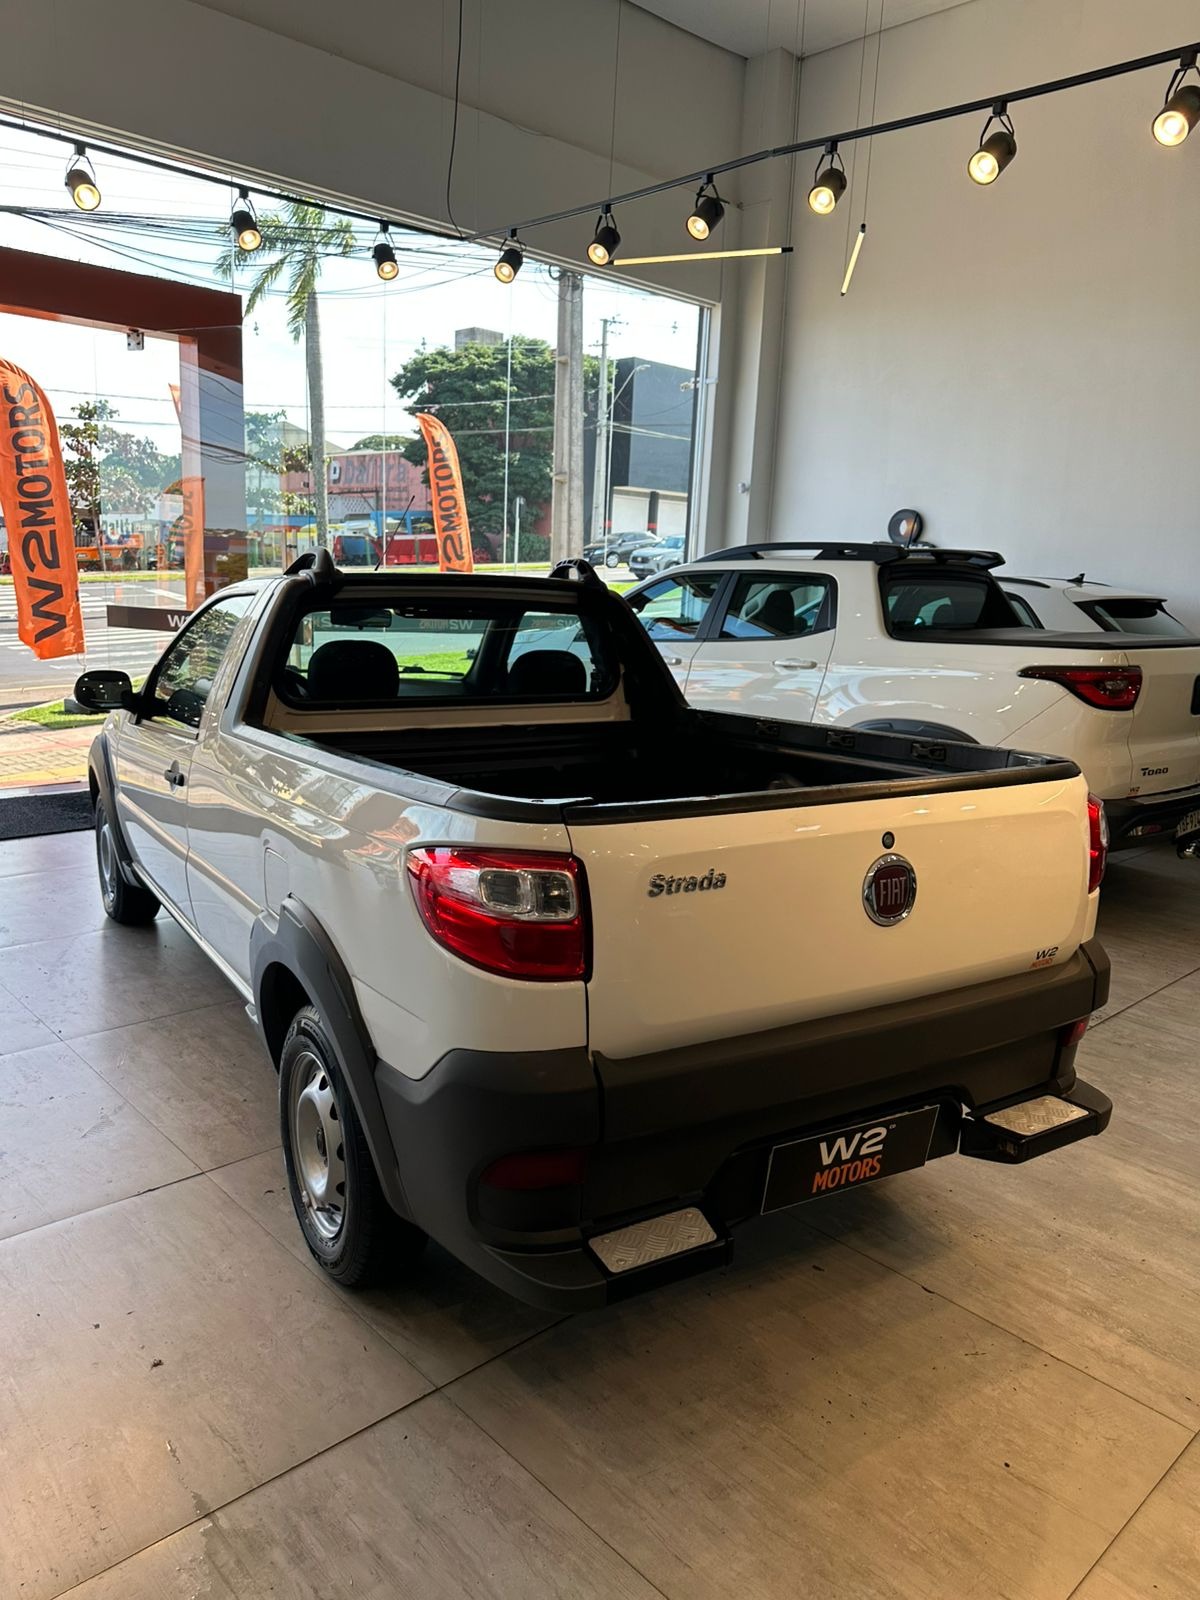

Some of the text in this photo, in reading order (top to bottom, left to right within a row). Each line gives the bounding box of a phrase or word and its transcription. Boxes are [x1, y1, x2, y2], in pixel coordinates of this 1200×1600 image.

[648, 867, 728, 899] Strada
[878, 875, 909, 908] FIAT
[1035, 945, 1060, 961] W2
[819, 1127, 888, 1166] W2
[812, 1155, 882, 1194] MOTORS
